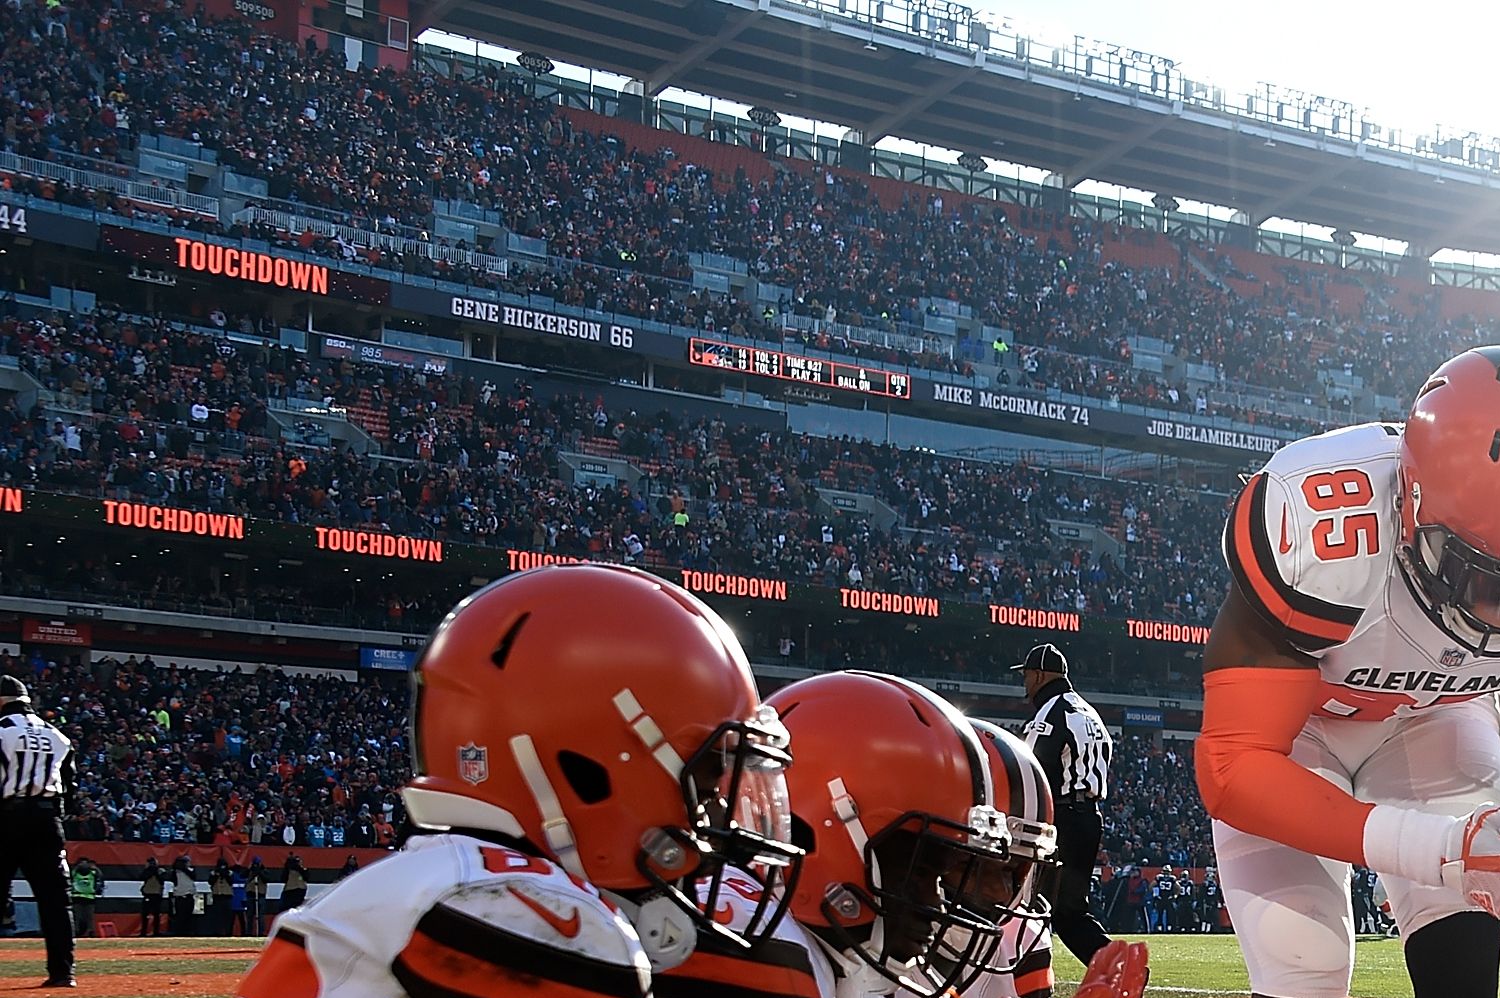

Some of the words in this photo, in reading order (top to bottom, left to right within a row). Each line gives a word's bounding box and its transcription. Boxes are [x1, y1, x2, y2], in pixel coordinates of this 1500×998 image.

[175, 238, 328, 295] TOUCHDOWN
[451, 297, 499, 323] GENE
[503, 306, 601, 341] HICKERSON
[610, 325, 634, 349] 66
[755, 351, 771, 363] TOL
[772, 354, 778, 365] 2
[755, 362, 771, 374] TOL
[786, 356, 806, 369] TIME
[791, 370, 811, 382] PLAY
[838, 376, 858, 389] BALL
[859, 380, 871, 391] ON
[895, 386, 902, 396] 2
[934, 383, 972, 405] MIKE
[1071, 405, 1089, 426] 74
[1147, 420, 1173, 438] JOE
[103, 500, 244, 539] TOUCHDOWN
[1302, 469, 1381, 563] 85
[315, 527, 442, 562] TOUCHDOWN
[681, 570, 787, 600] TOUCHDOWN
[840, 588, 939, 617] TOUCHDOWN
[989, 605, 1080, 631] TOUCHDOWN
[1127, 619, 1212, 644] TOUCHDOWN
[1029, 721, 1047, 733] 43
[1085, 722, 1103, 741] 43
[18, 735, 53, 752] 133
